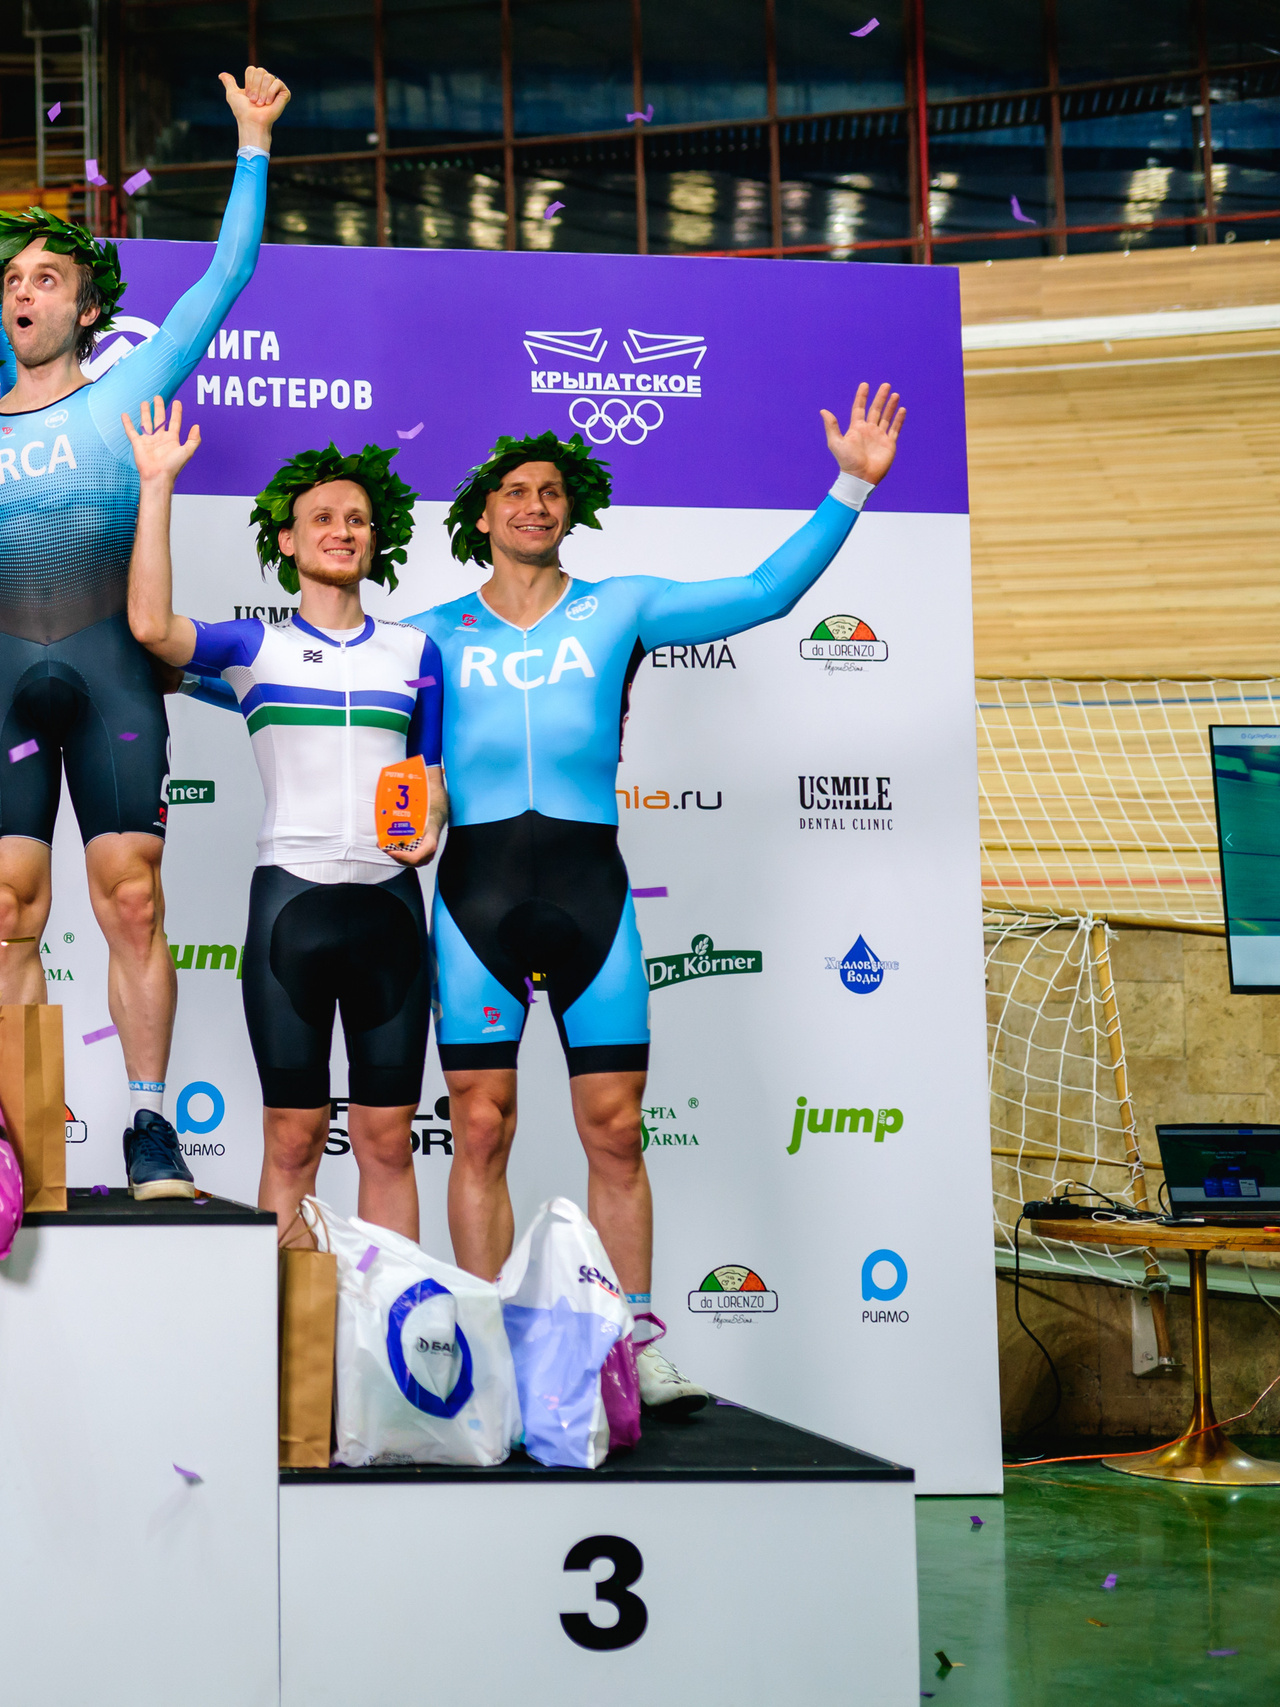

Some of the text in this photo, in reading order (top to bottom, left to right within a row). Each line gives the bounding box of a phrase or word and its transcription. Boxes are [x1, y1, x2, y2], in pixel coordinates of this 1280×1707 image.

[197, 375, 373, 410] МАСТЕРОВ
[531, 370, 701, 393] КРЫЛАТСКОЕ
[460, 636, 596, 690] RCA
[651, 643, 736, 669] ERMA
[812, 645, 875, 657] da LORENZO
[396, 785, 410, 810] 3
[798, 776, 892, 811] USMILE
[799, 818, 893, 830] DENTAL CLINIC
[649, 955, 756, 985] Dr. Körner
[143, 1083, 164, 1092] RCA
[786, 1096, 904, 1155] jump
[700, 1296, 764, 1308] da LORENZO
[862, 1311, 909, 1323] PUAMO
[559, 1535, 648, 1652] 3
